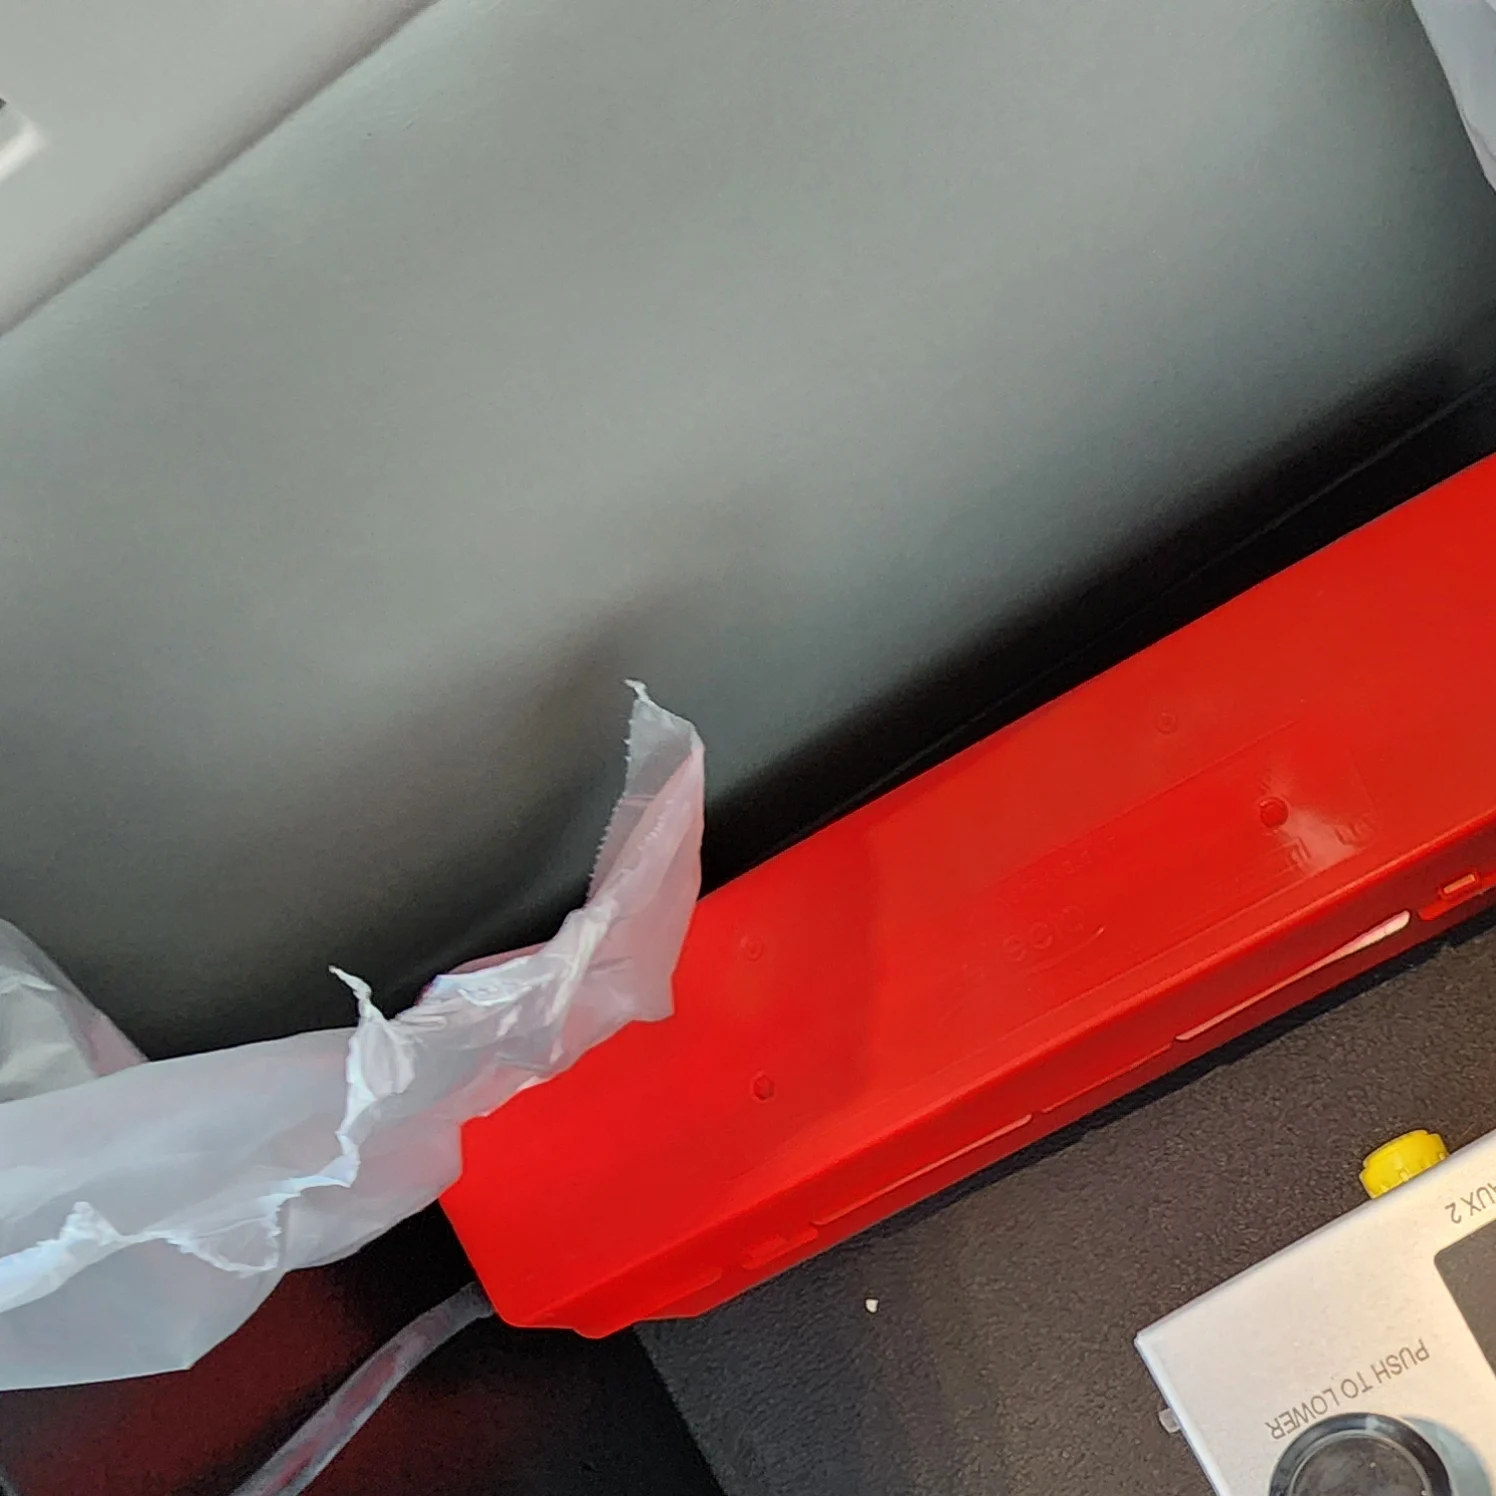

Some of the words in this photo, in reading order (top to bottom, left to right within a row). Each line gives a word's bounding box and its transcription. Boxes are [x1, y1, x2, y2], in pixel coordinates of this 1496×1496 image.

[1445, 1202, 1463, 1224] 2
[1372, 1338, 1430, 1385] PUSH
[1341, 1370, 1374, 1398] TO
[1265, 1388, 1342, 1440] LOWER
